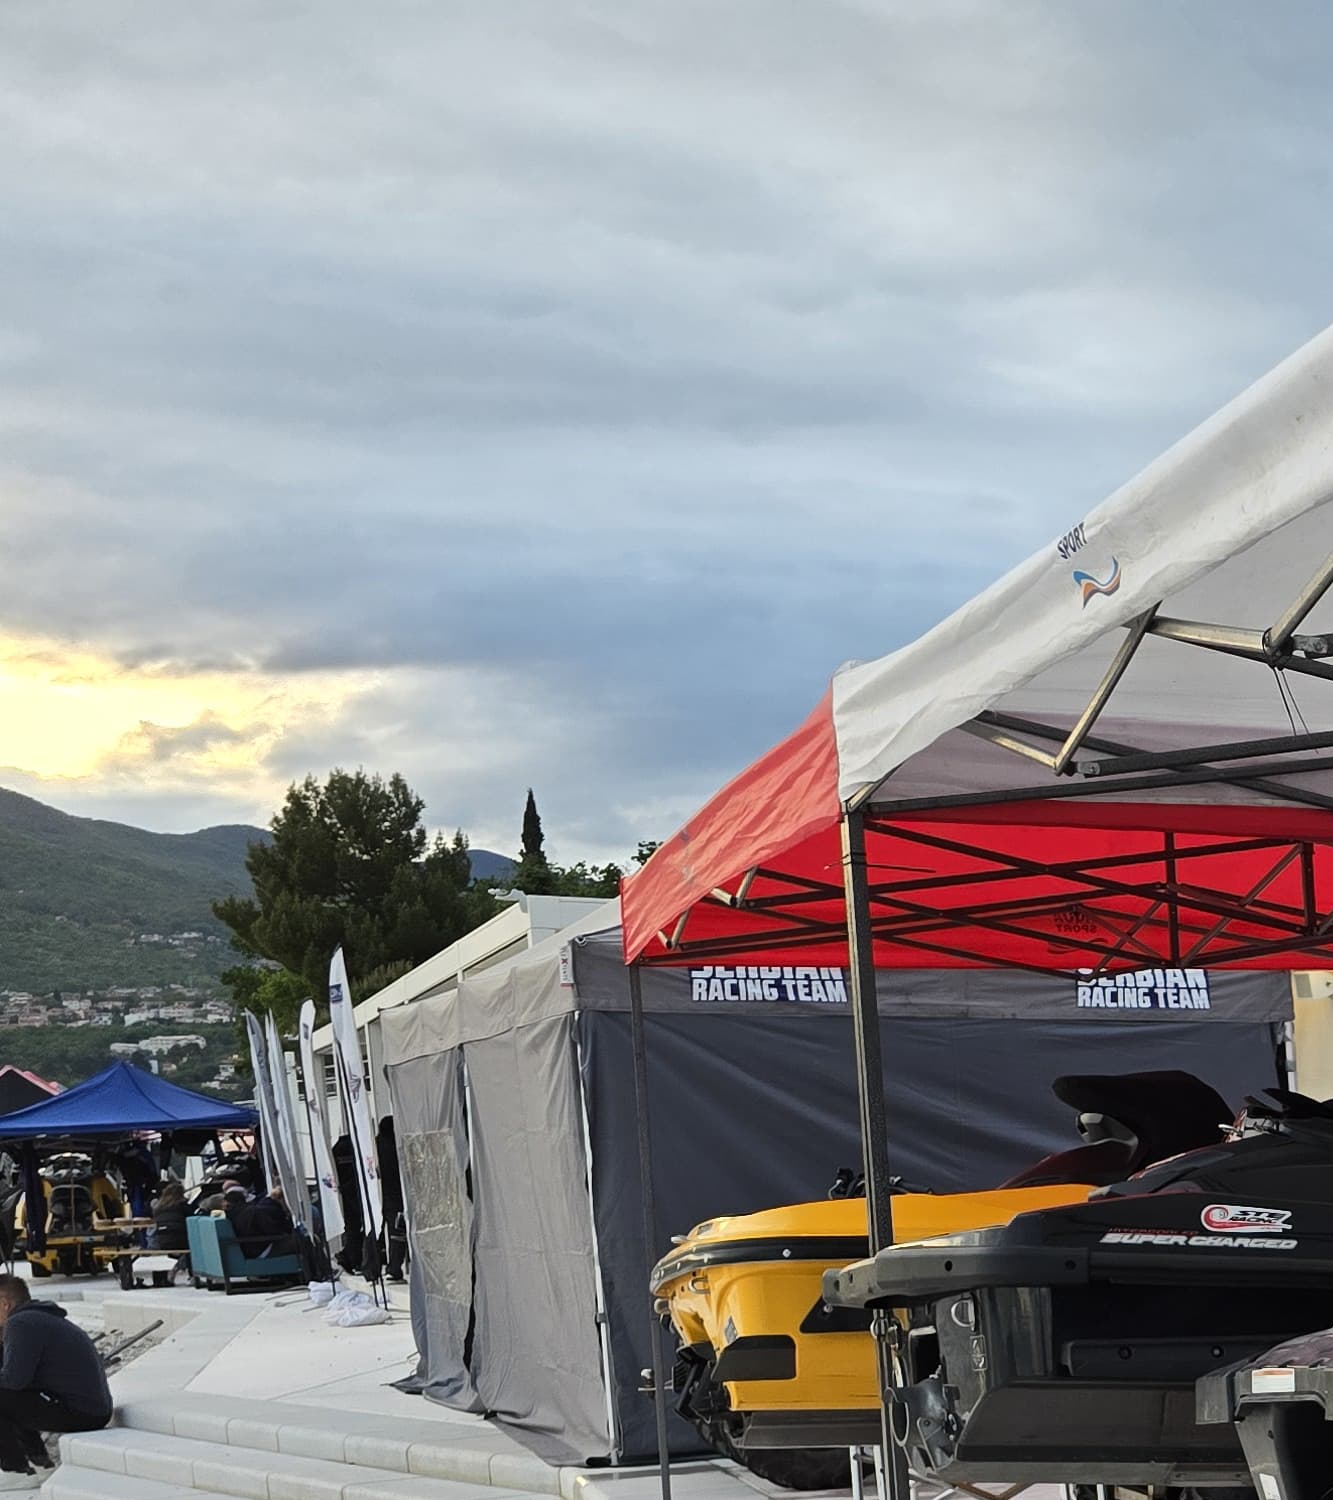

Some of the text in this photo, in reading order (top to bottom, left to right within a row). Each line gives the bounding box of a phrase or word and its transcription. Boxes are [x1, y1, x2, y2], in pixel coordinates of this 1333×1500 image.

[1057, 521, 1087, 560] SPORT
[692, 978, 848, 1003] RACING TEAM
[1077, 986, 1210, 1009] RACING TEAM
[1100, 1231, 1298, 1250] SUPER CHARGED
